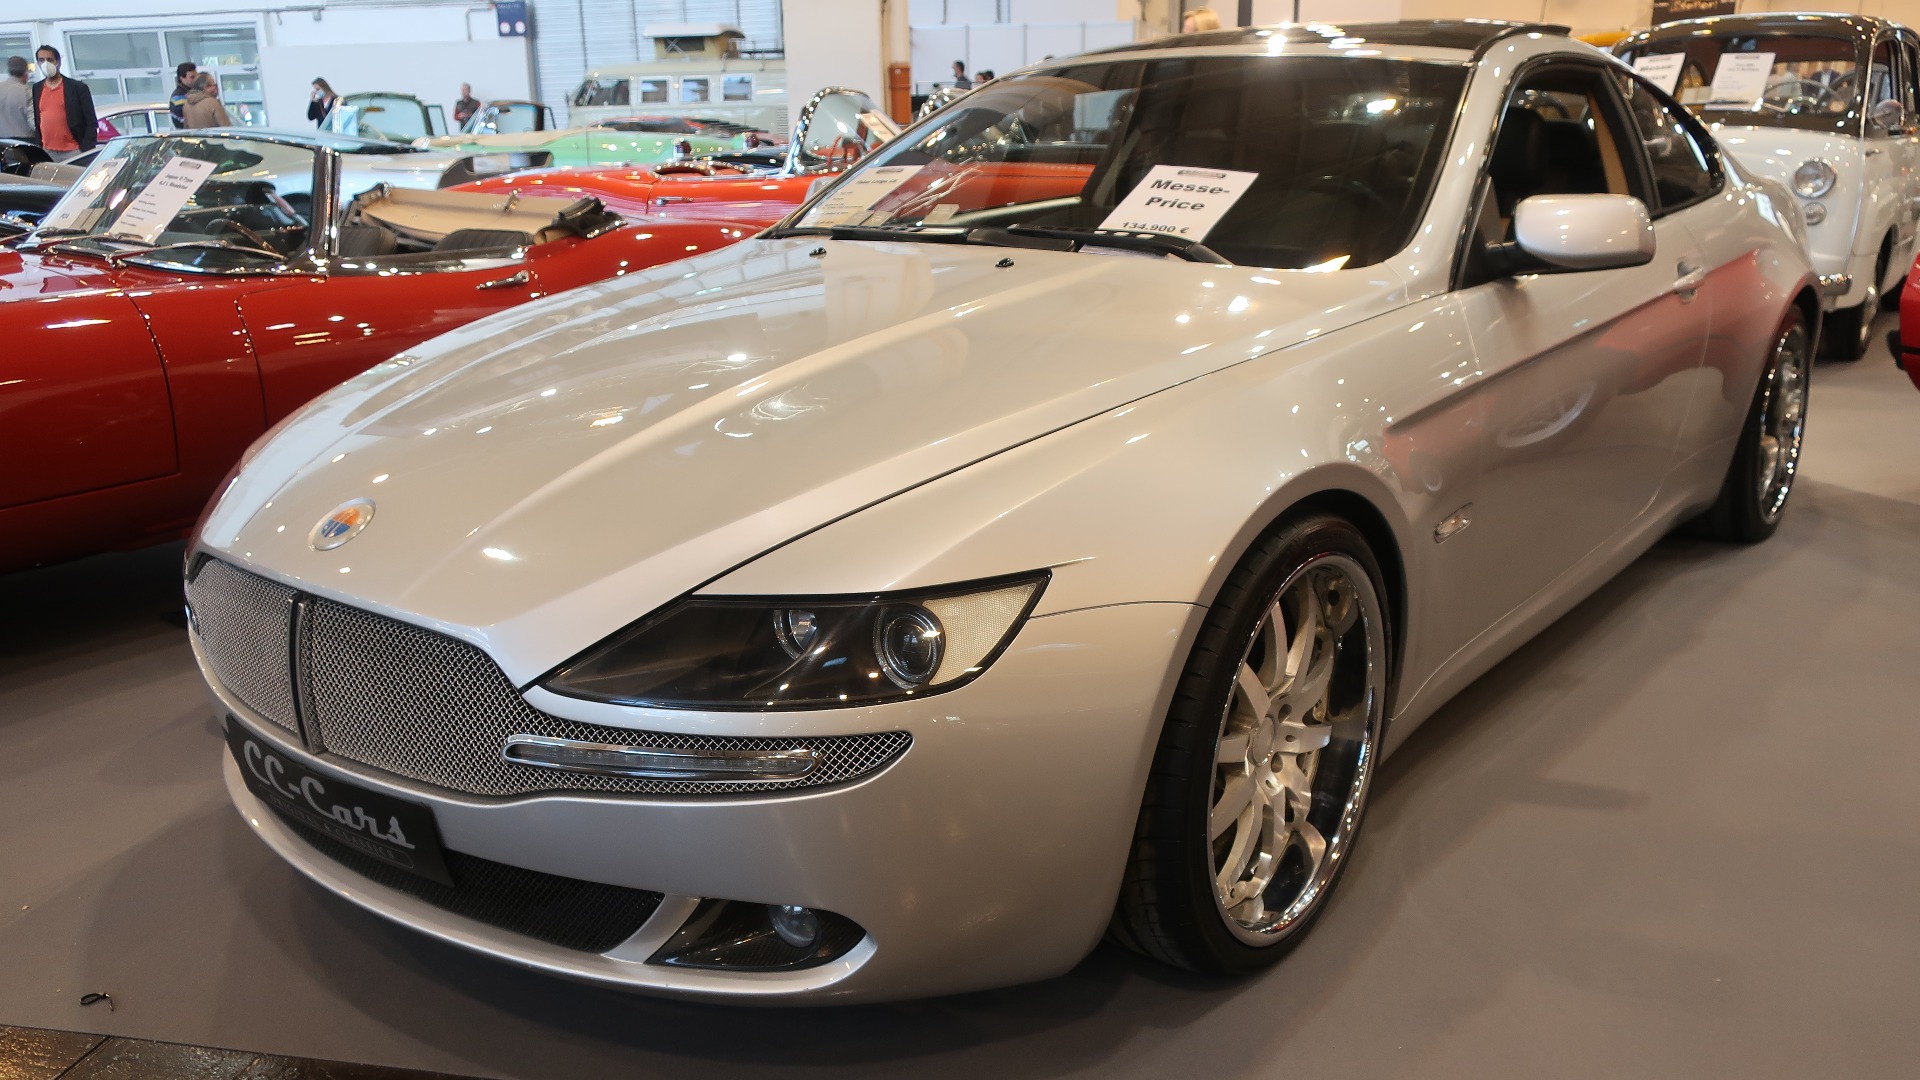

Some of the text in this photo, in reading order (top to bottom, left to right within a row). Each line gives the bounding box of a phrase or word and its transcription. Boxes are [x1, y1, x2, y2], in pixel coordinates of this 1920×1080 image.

[1150, 178, 1231, 195] Messe-
[1145, 196, 1206, 211] Price
[1122, 221, 1190, 234] 134.900 €
[243, 740, 416, 850] CC-Cars
